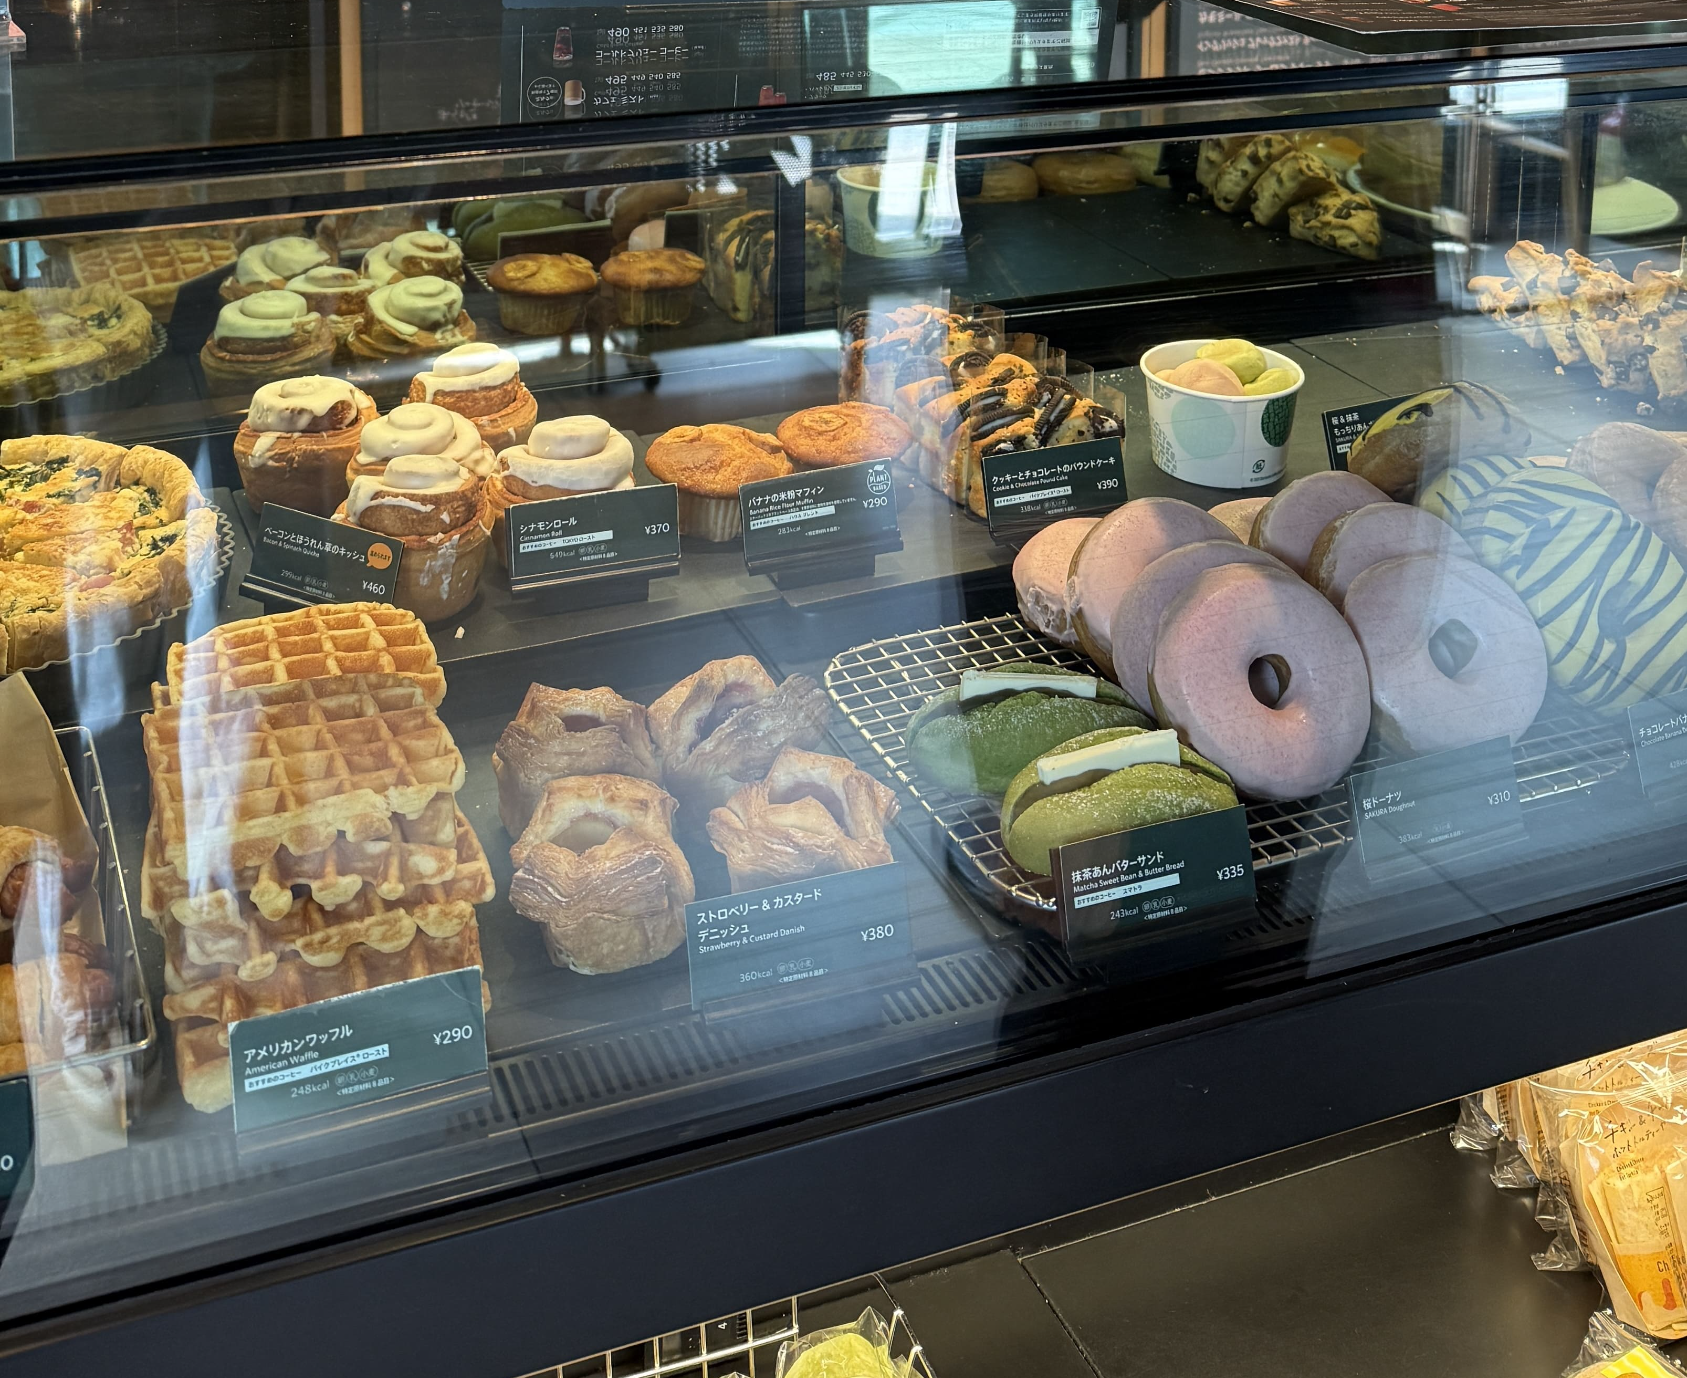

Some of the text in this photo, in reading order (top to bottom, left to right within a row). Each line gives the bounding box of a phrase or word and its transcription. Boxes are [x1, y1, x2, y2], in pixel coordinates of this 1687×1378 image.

[1097, 478, 1118, 490] ¥390
[748, 486, 824, 507] バナナの米粉マフィン
[863, 497, 888, 509] ¥290
[520, 517, 577, 533] シナモンロール
[645, 523, 670, 535] ¥370
[264, 527, 365, 562] ベーコンとほうれん草のキッシュ
[362, 580, 385, 595] ¥460
[1363, 791, 1402, 810] 桜ドーナツ
[1487, 790, 1511, 806] ¥310
[1364, 800, 1416, 820] SAKURA Doughnut
[1071, 851, 1165, 884] 抹茶あんバターサンド
[1073, 882, 1099, 894] Matcha
[1099, 877, 1120, 888] Sweet
[1121, 873, 1137, 883] Bean
[1144, 865, 1164, 877] Butter
[1166, 860, 1185, 871] Bread
[1217, 864, 1244, 881] ¥335
[697, 888, 822, 925] ストロベリー & カスタード
[1110, 907, 1139, 921] 243kcal
[698, 922, 750, 943] デニッシュ
[698, 925, 805, 954] Strawberry & Custard Danish
[861, 924, 895, 942] ¥380
[740, 968, 773, 983] 360kcal
[243, 1024, 353, 1064] アメリカンワッフル
[433, 1025, 473, 1045] ¥290
[244, 1050, 320, 1076] American Waffle
[248, 1070, 302, 1089] おすすめのコーヒー
[362, 1047, 388, 1060] ロースト
[291, 1080, 330, 1098] 248kcal
